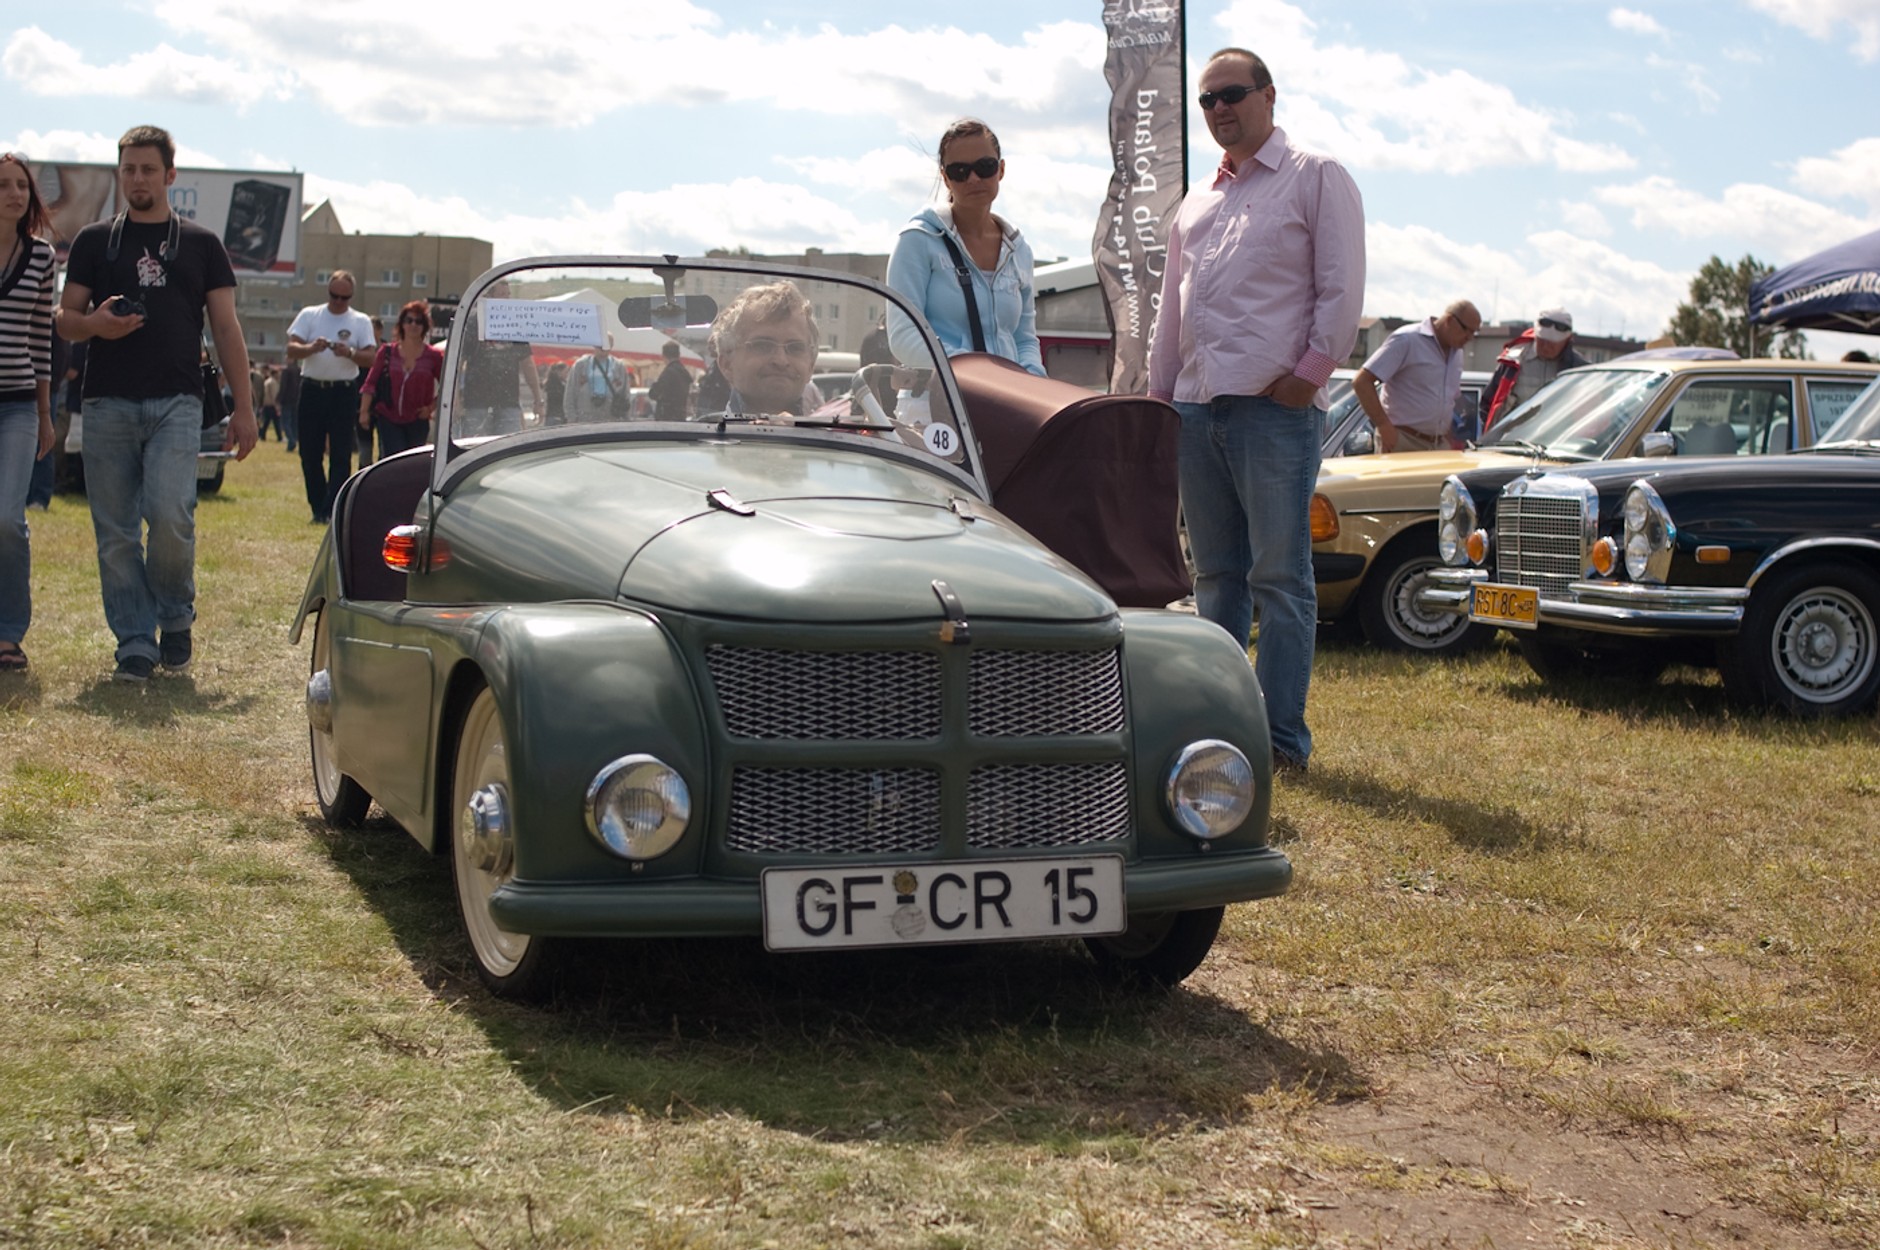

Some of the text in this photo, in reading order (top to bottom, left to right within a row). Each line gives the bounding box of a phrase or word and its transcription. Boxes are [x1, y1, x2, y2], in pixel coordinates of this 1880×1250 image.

[933, 429, 949, 450] 48
[1476, 589, 1498, 615] RST
[1044, 867, 1098, 925] 15
